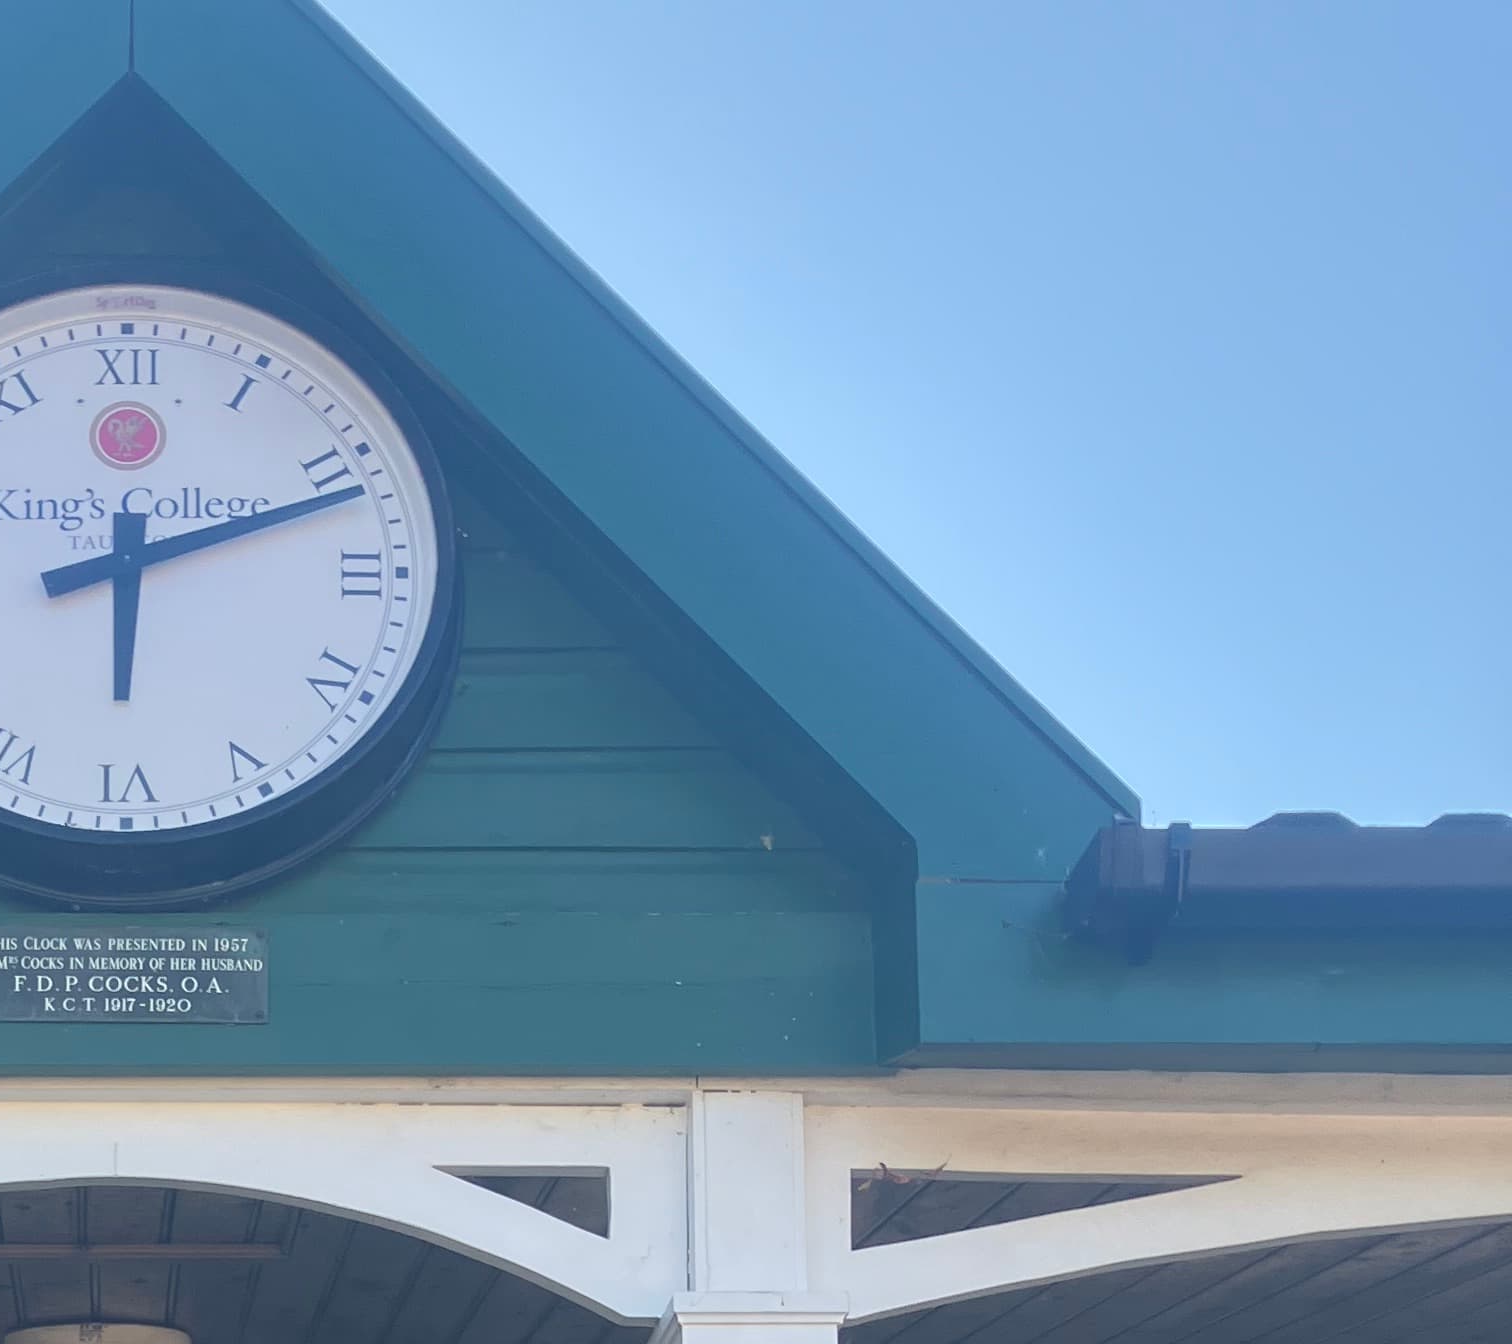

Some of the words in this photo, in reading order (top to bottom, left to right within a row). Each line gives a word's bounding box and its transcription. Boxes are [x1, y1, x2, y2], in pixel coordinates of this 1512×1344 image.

[95, 349, 159, 386] XII
[222, 373, 260, 412] I
[299, 444, 354, 494] II
[121, 487, 271, 521] College
[340, 548, 382, 600] III
[305, 647, 362, 712] IV
[227, 741, 268, 783] V
[97, 763, 160, 803] VI
[23, 936, 68, 951] CLOCK
[74, 938, 101, 951] WAS
[108, 938, 185, 952] PRESENTED
[191, 939, 208, 952] IN
[214, 938, 249, 952] 1957
[21, 956, 64, 970] COCKS
[69, 957, 85, 970] IN
[88, 957, 146, 971] MEMORY
[149, 957, 166, 971] OF
[170, 958, 196, 971] HER
[201, 958, 263, 972] HUSBAND
